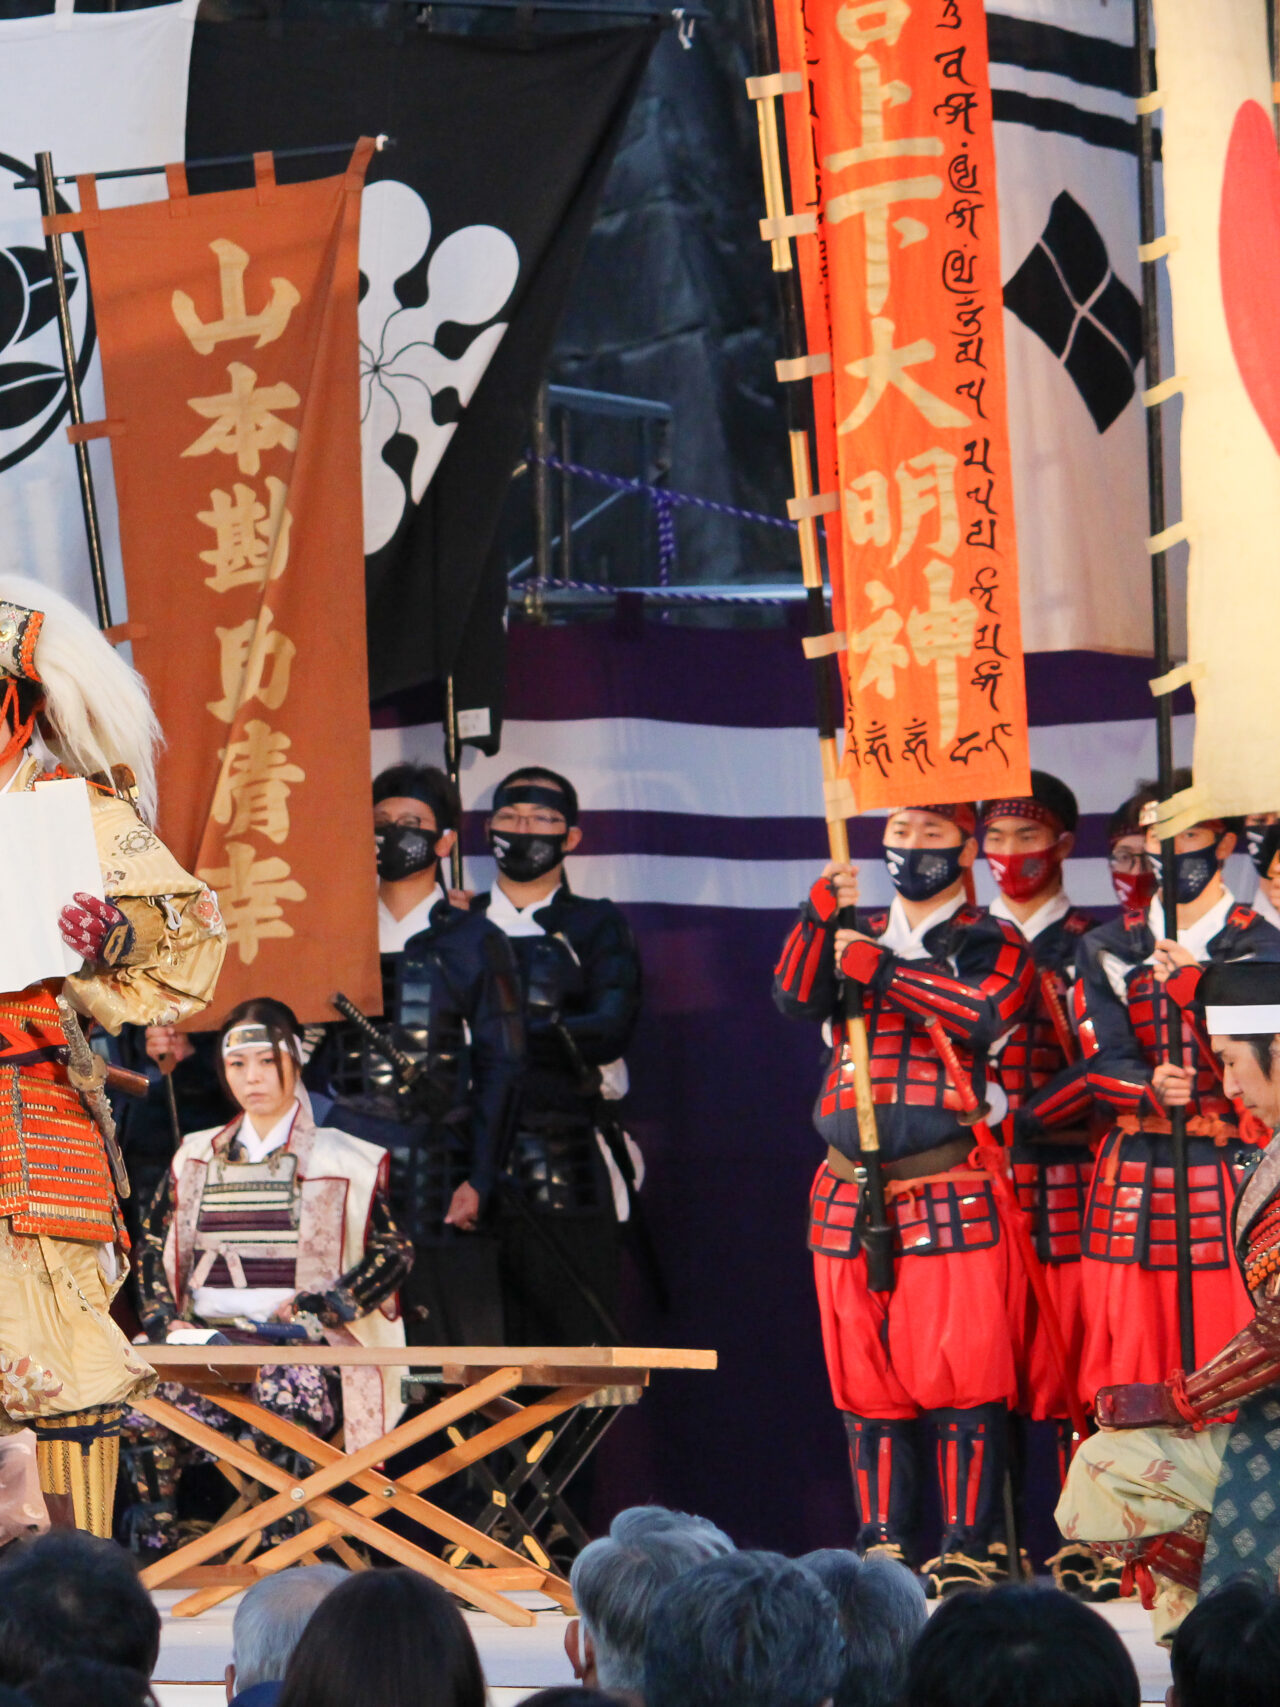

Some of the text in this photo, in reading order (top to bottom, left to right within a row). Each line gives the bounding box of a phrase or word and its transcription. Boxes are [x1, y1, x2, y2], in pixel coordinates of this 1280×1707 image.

[172, 239, 307, 965] 山本勘助晴幸
